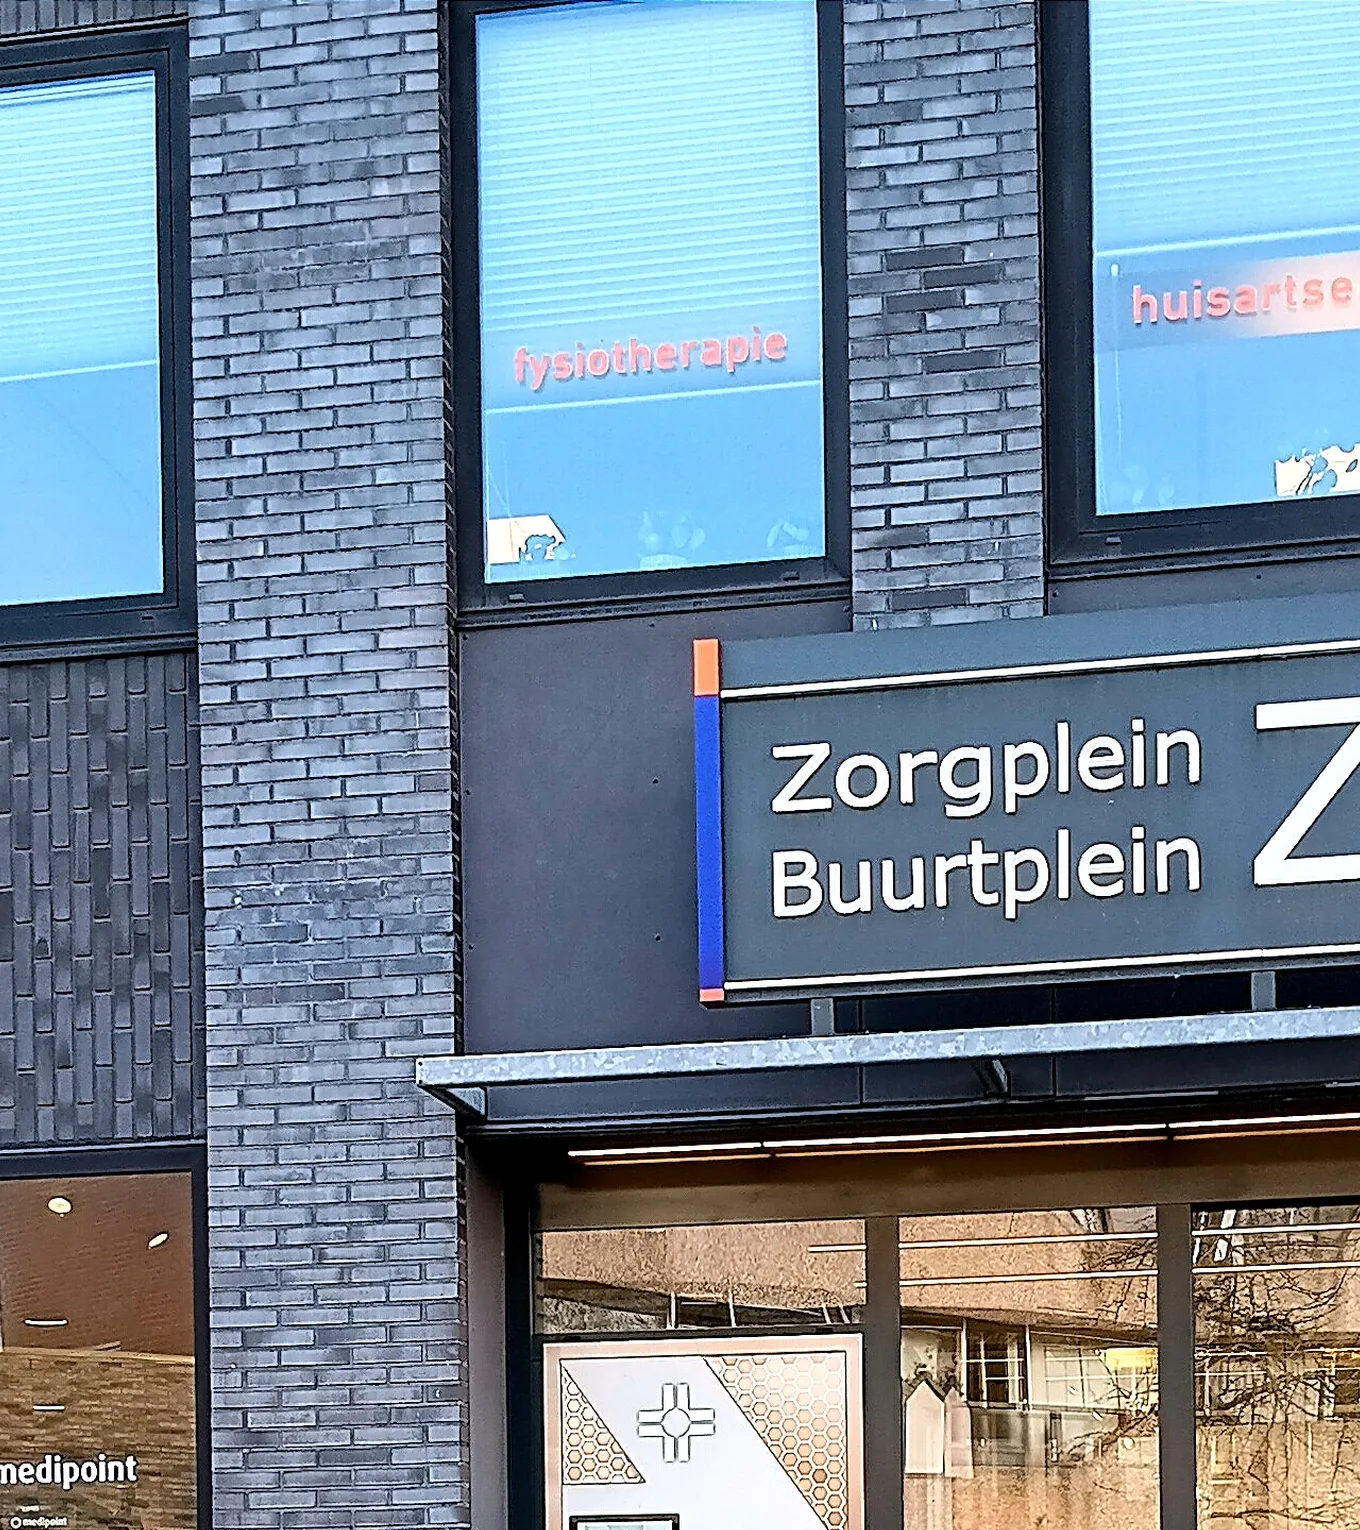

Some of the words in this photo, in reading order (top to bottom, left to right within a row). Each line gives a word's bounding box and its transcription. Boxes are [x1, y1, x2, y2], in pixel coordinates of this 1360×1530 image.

[513, 325, 788, 391] fysiotherapie
[770, 716, 1202, 818] Zorgplein
[771, 826, 1202, 921] Buurtplein
